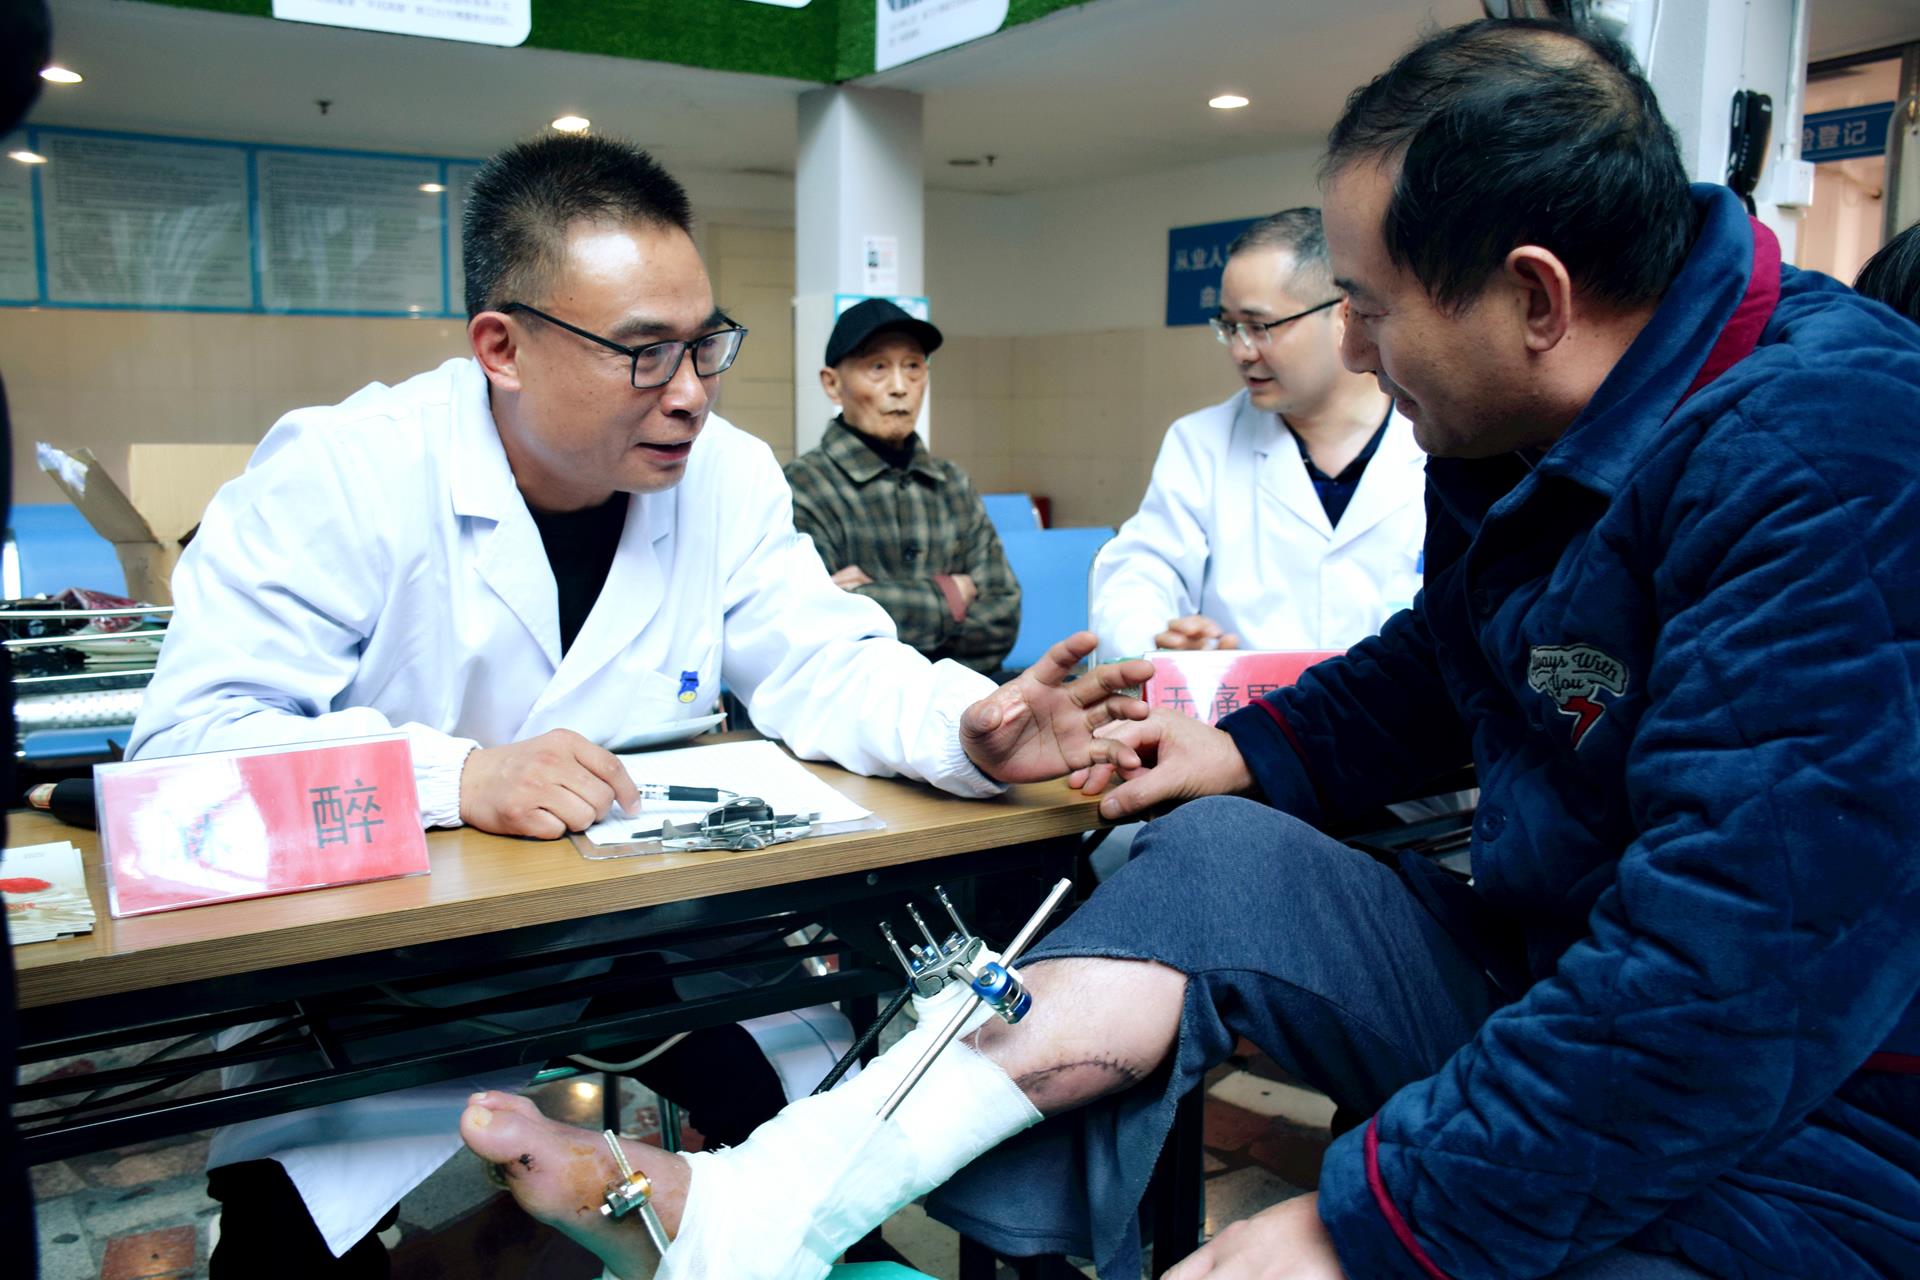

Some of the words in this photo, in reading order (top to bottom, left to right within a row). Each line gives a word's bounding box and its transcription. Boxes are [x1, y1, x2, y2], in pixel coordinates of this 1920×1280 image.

[1174, 244, 1230, 272] 从业人
[1571, 652, 1618, 681] With
[1548, 674, 1585, 697] You
